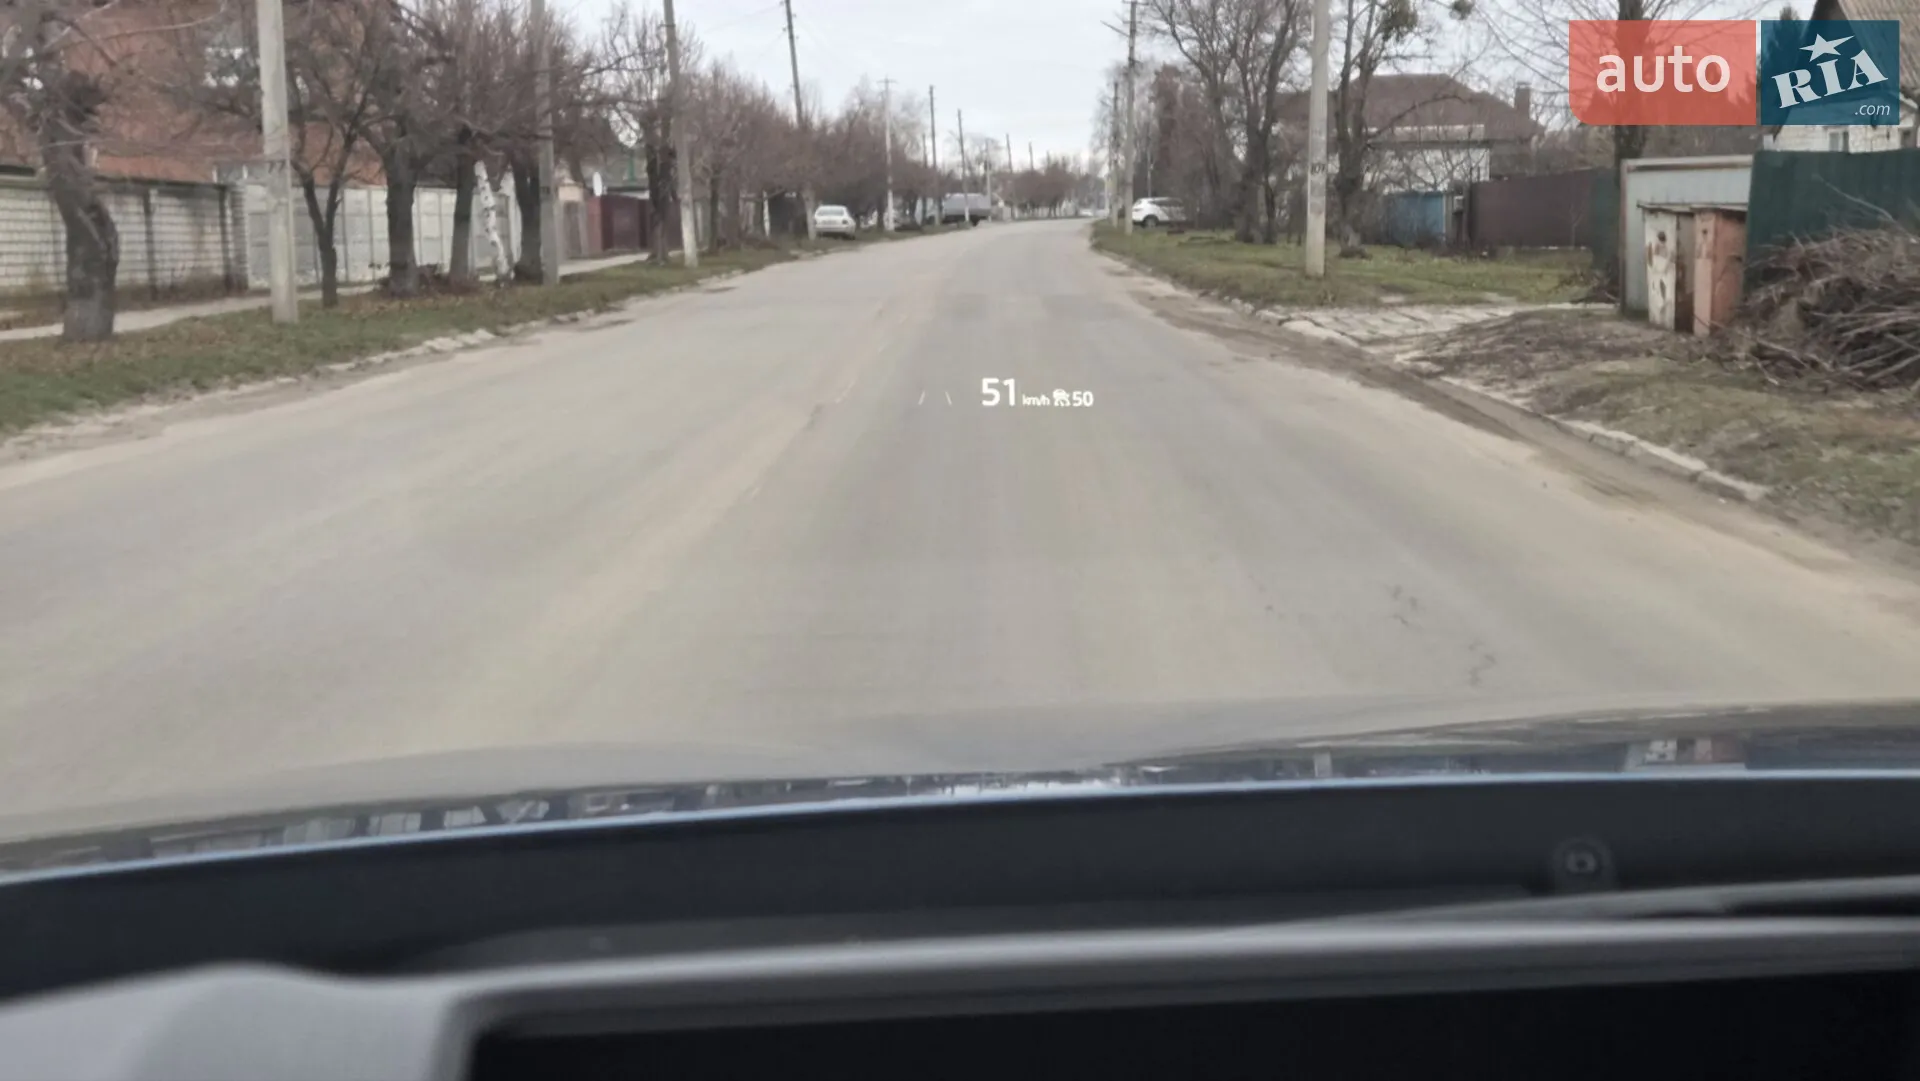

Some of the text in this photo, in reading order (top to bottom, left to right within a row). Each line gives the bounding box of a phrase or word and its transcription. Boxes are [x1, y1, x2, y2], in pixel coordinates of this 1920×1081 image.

[981, 377, 1094, 407] 51 km/h 50
